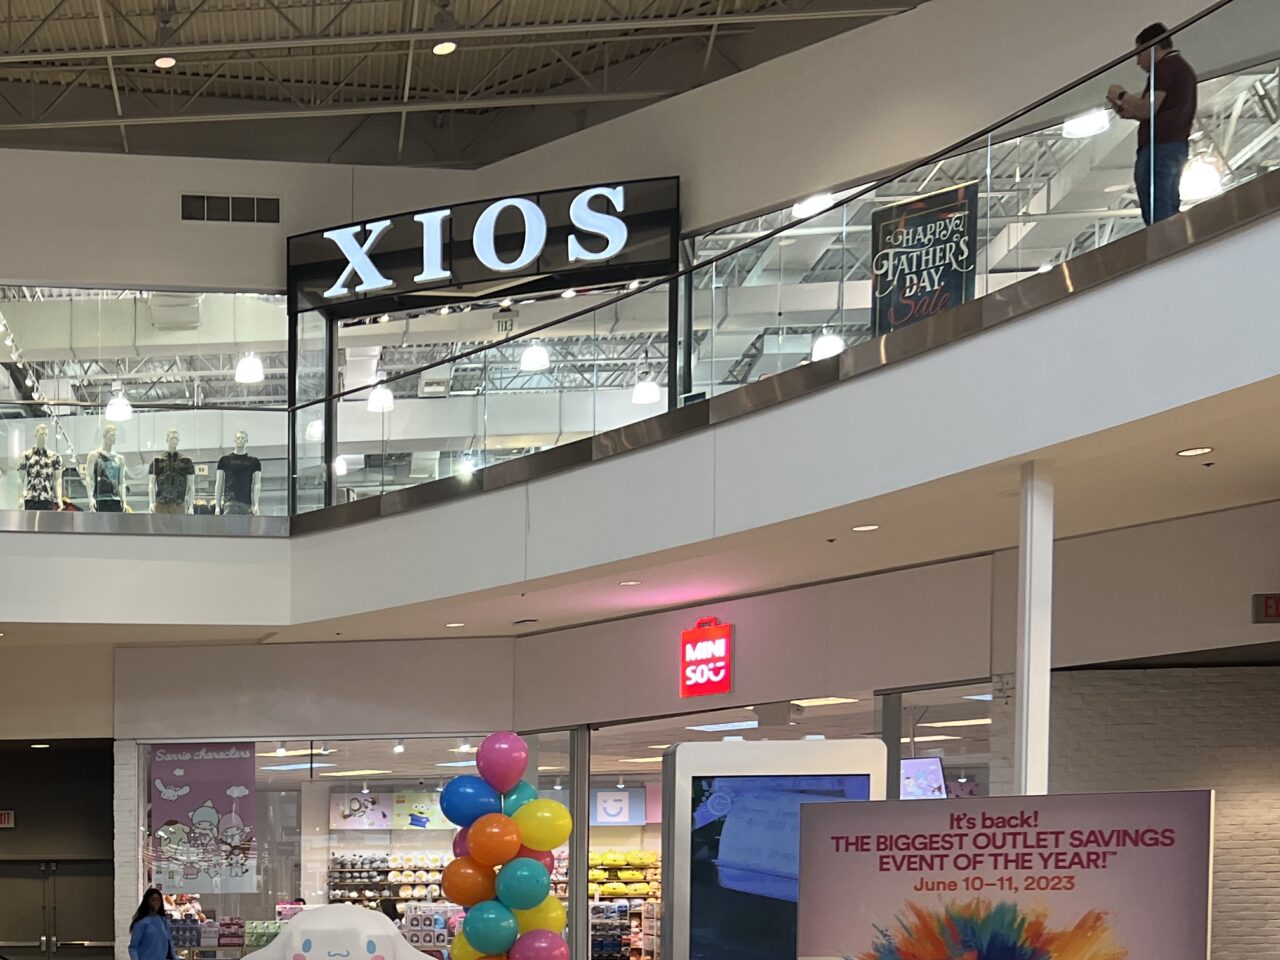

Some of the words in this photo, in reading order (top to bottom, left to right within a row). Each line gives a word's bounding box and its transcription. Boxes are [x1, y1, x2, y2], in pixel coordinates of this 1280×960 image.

[886, 211, 969, 247] HAPPY
[323, 186, 628, 298] XIOS
[873, 235, 974, 297] FATHER'S
[888, 287, 950, 325] Sale
[685, 638, 726, 662] MINI
[155, 749, 192, 761] Sanrio
[194, 746, 250, 760] characters
[981, 810, 1039, 829] back!
[831, 835, 871, 852] THE
[876, 832, 969, 852] BIGGEST
[973, 830, 1065, 850] OUTLET
[1069, 828, 1176, 848] SAVINGS
[879, 854, 950, 872] EVENT
[953, 853, 984, 871] OF
[989, 853, 1033, 870] THE
[913, 877, 958, 893] June
[1024, 875, 1076, 891] 2023
